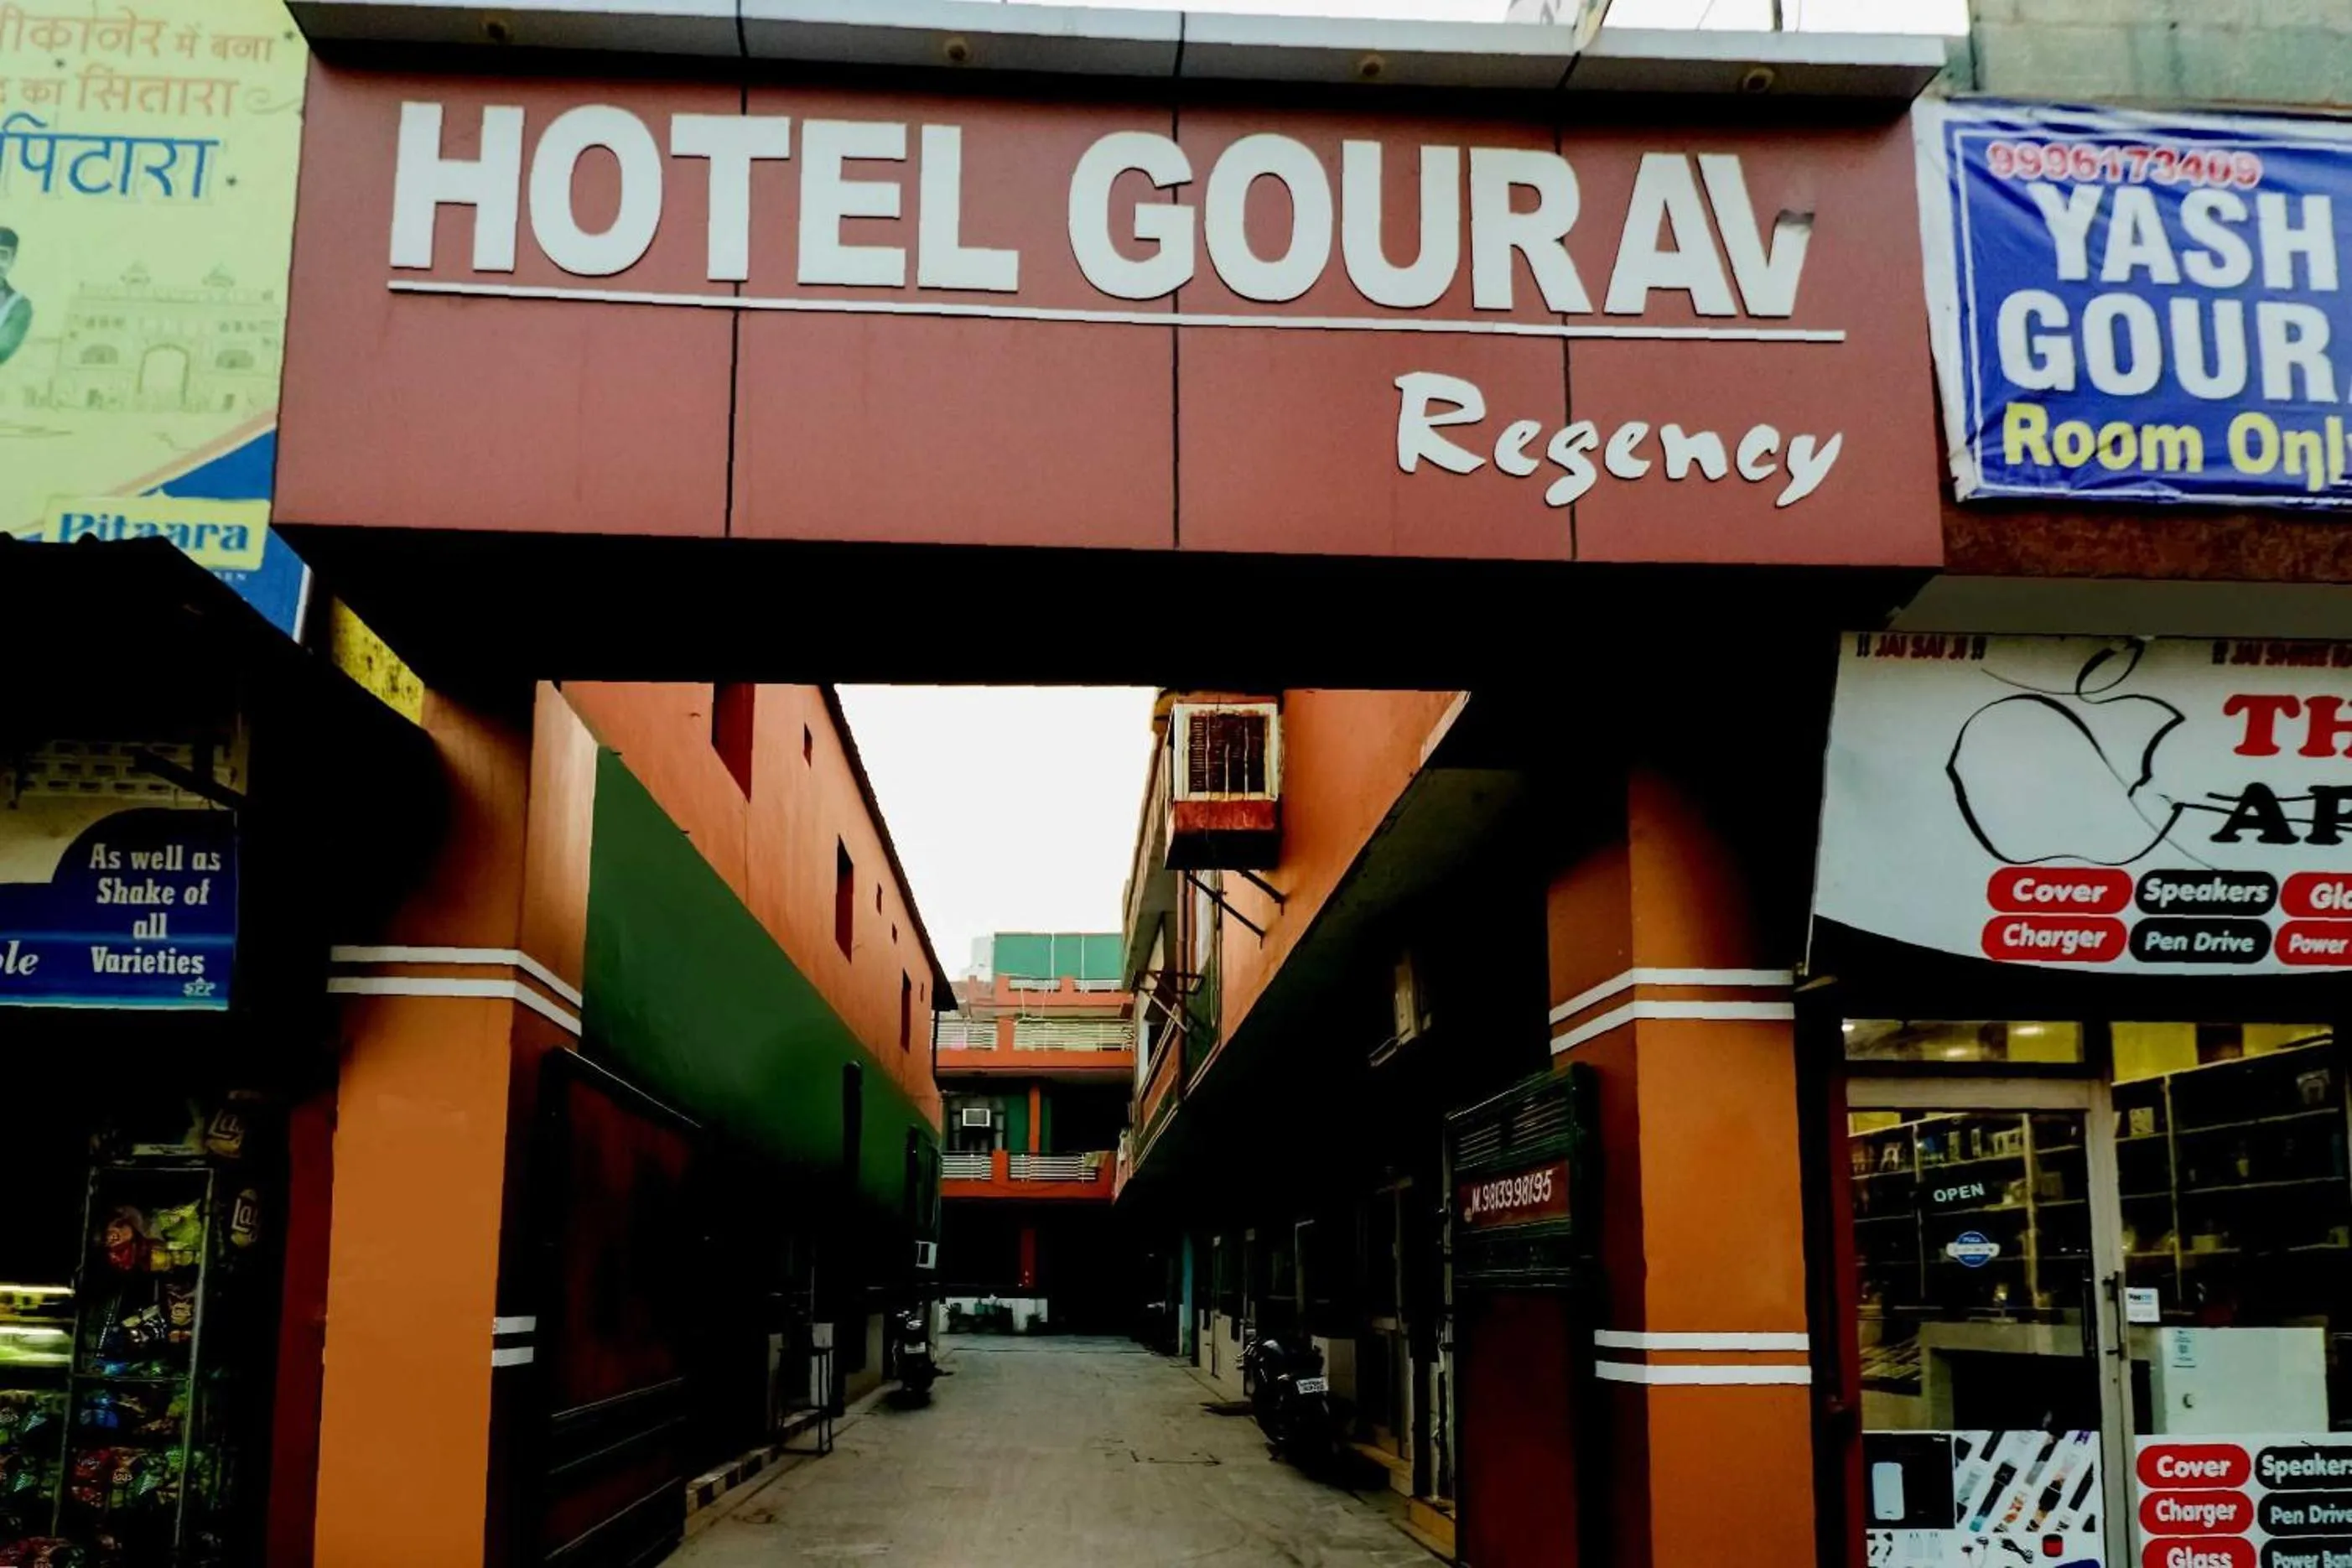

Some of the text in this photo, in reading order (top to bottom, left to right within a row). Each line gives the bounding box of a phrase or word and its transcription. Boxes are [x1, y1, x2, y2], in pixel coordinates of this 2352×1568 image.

[388, 101, 1815, 317] HOTEL GOURAV
[2027, 182, 2338, 291] YASH
[1997, 289, 2352, 402] GOUR
[1394, 371, 1843, 506] Regency
[2002, 402, 2204, 473] Room
[89, 843, 221, 871] As well as
[96, 877, 210, 906] Shake of
[2012, 878, 2107, 903] Cover
[2143, 876, 2269, 902] Speakers
[132, 912, 168, 939] all
[2003, 923, 2107, 950] Charger
[2145, 929, 2255, 953] Pen Drive
[2288, 932, 2349, 954] Power
[0, 940, 39, 975] le
[91, 946, 205, 974] Varieties
[1934, 1182, 1985, 1202] OPEN
[2157, 1455, 2231, 1478] Cover
[2156, 1498, 2237, 1528] Charger
[2270, 1505, 2304, 1524] Pen
[2167, 1546, 2233, 1568] Glass
[2322, 1549, 2352, 1568] Ban
